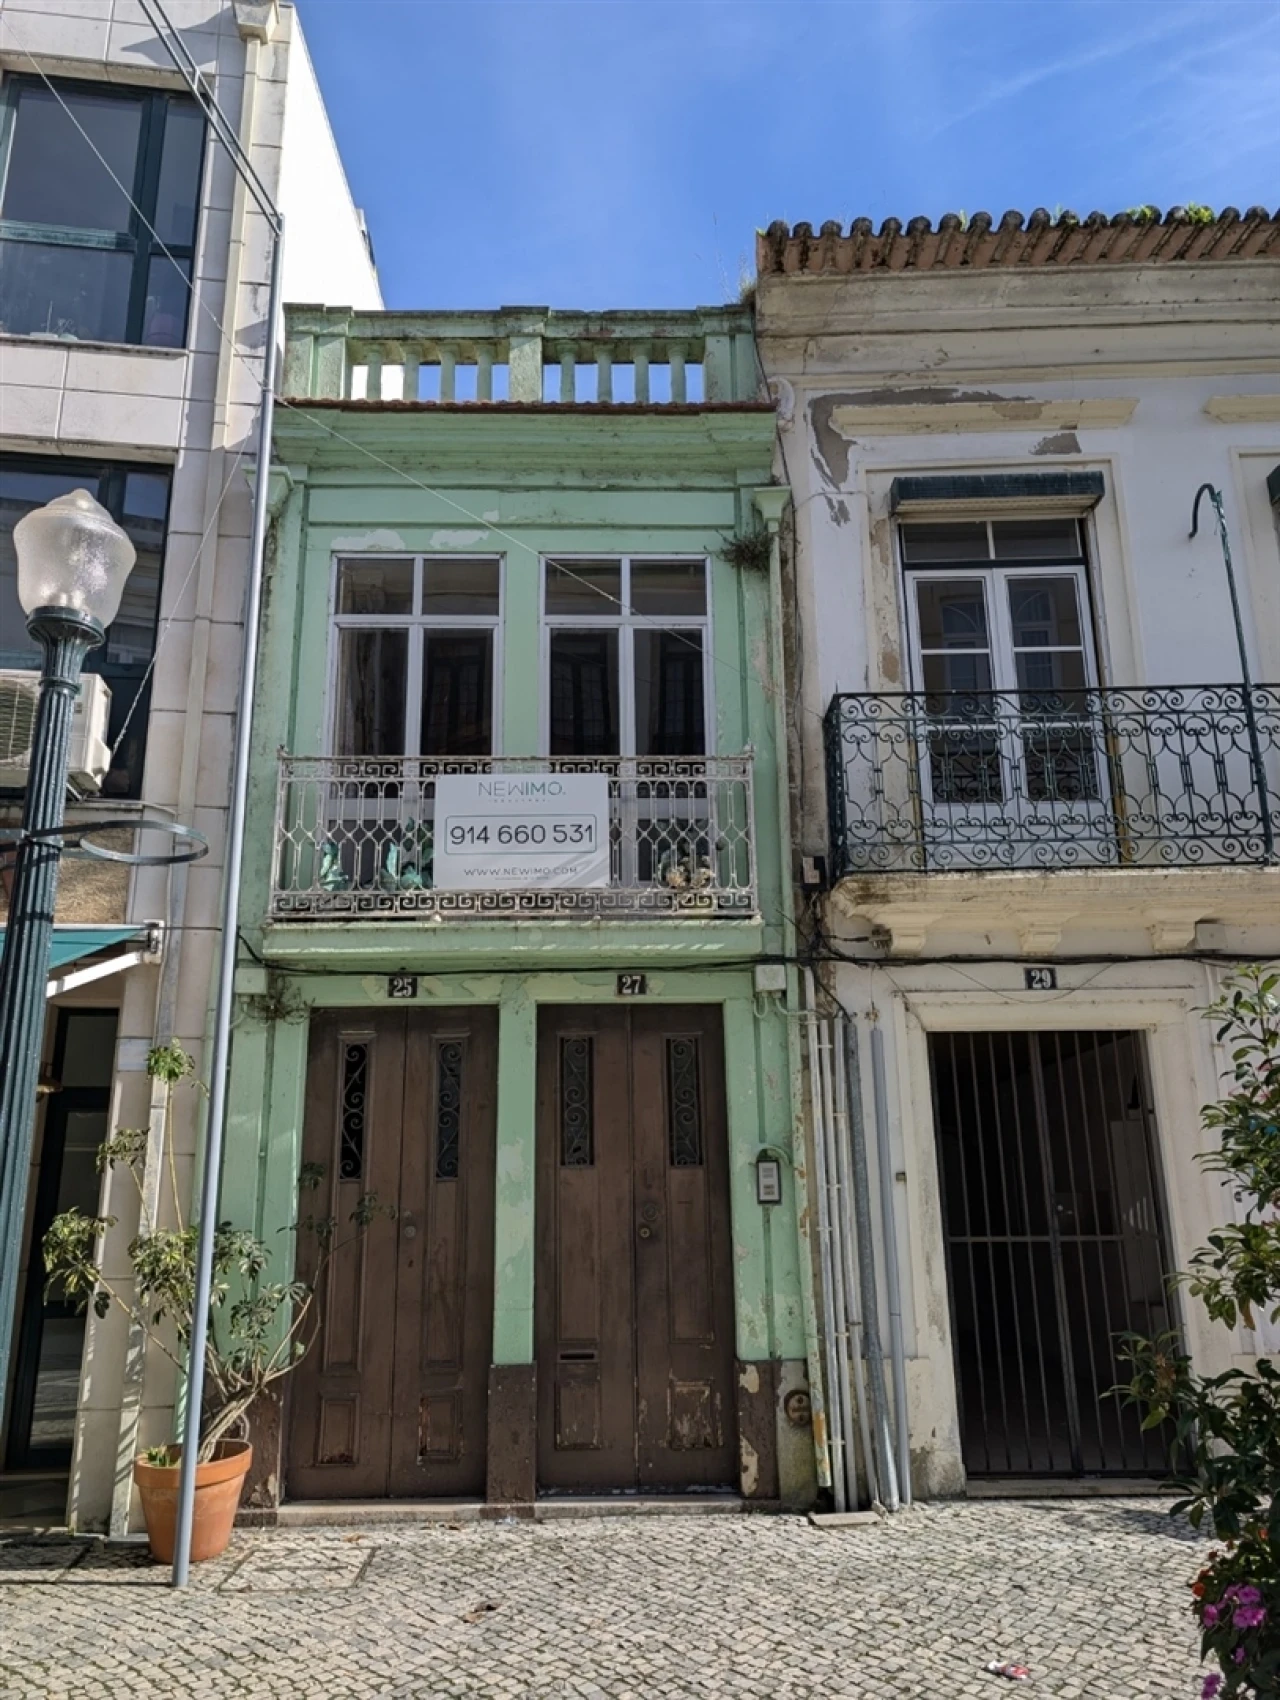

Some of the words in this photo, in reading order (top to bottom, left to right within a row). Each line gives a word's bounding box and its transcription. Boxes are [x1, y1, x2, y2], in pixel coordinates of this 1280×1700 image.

[450, 825, 490, 845] 914
[498, 824, 546, 844] 660
[553, 824, 593, 843] 531
[464, 866, 577, 876] WWW.NEWIMO.COM
[393, 978, 412, 997] 25
[622, 975, 641, 994] 27
[1031, 969, 1051, 988] 29
